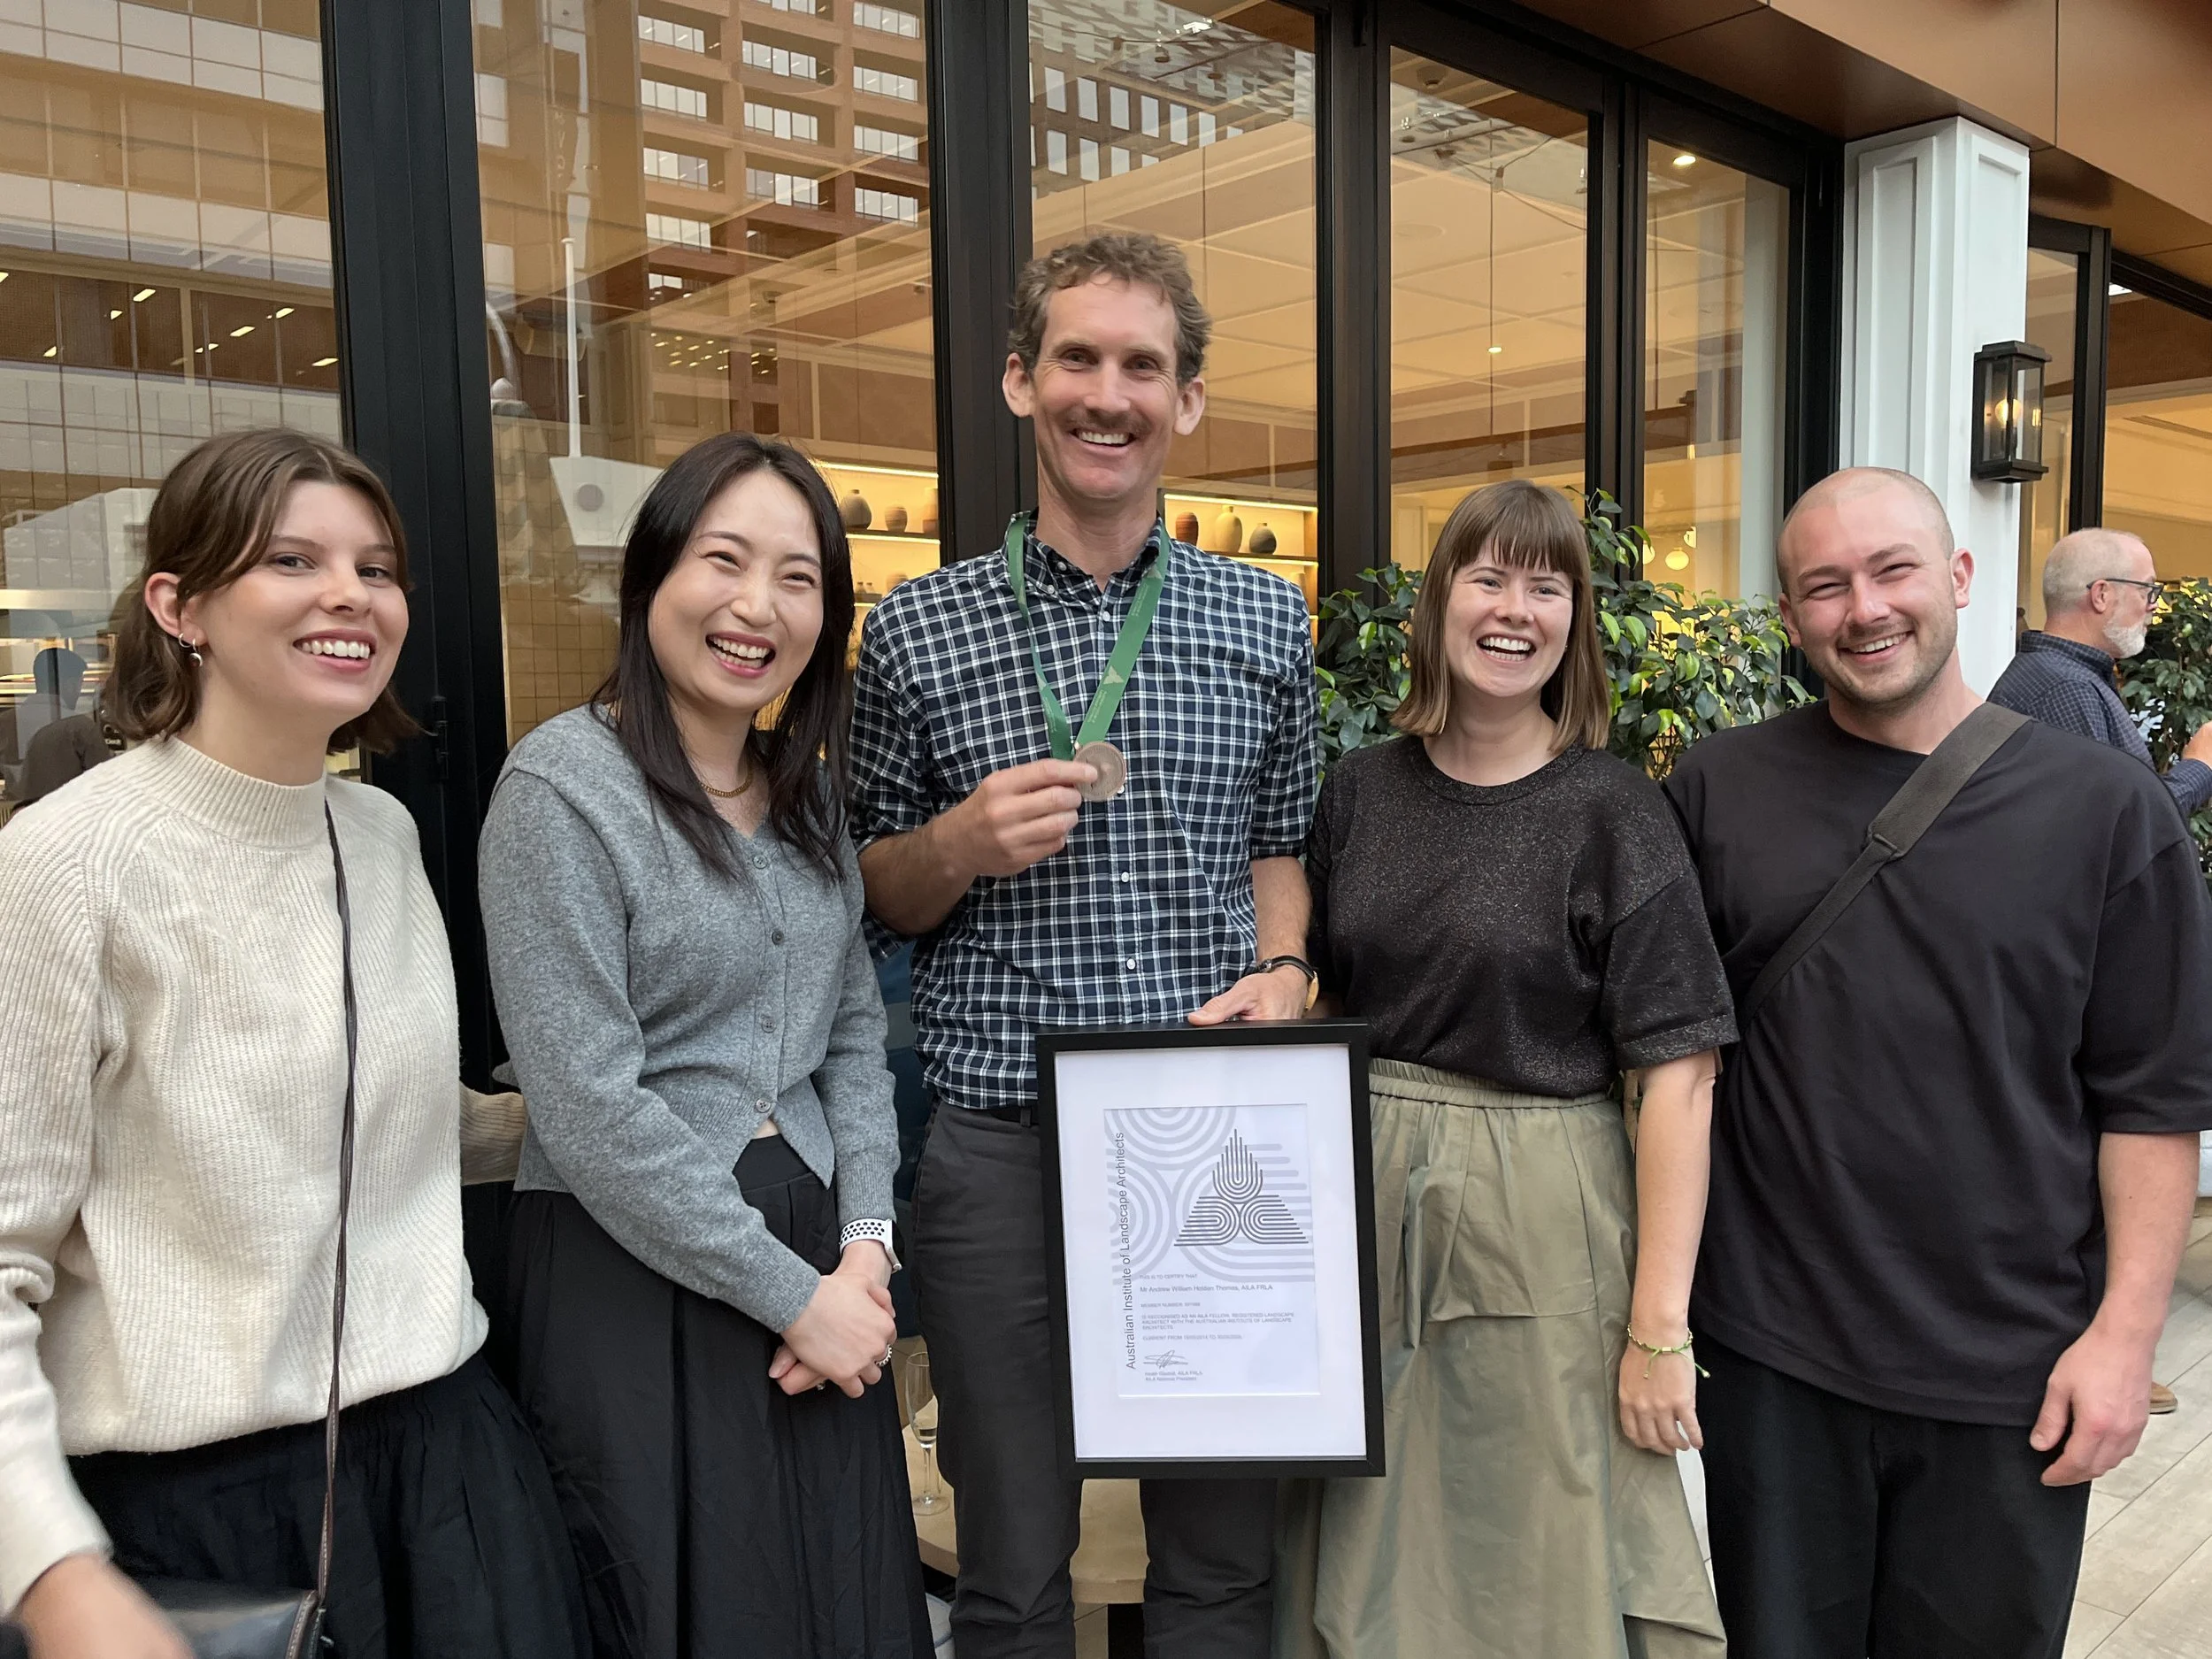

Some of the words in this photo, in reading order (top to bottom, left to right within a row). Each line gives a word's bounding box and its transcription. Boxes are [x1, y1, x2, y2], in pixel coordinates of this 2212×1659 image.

[1115, 1133, 1126, 1187] Architects
[1119, 1190, 1130, 1250] Landscape
[1120, 1255, 1131, 1264] of
[1122, 1268, 1133, 1310] Institute
[1125, 1315, 1136, 1369] Australian
